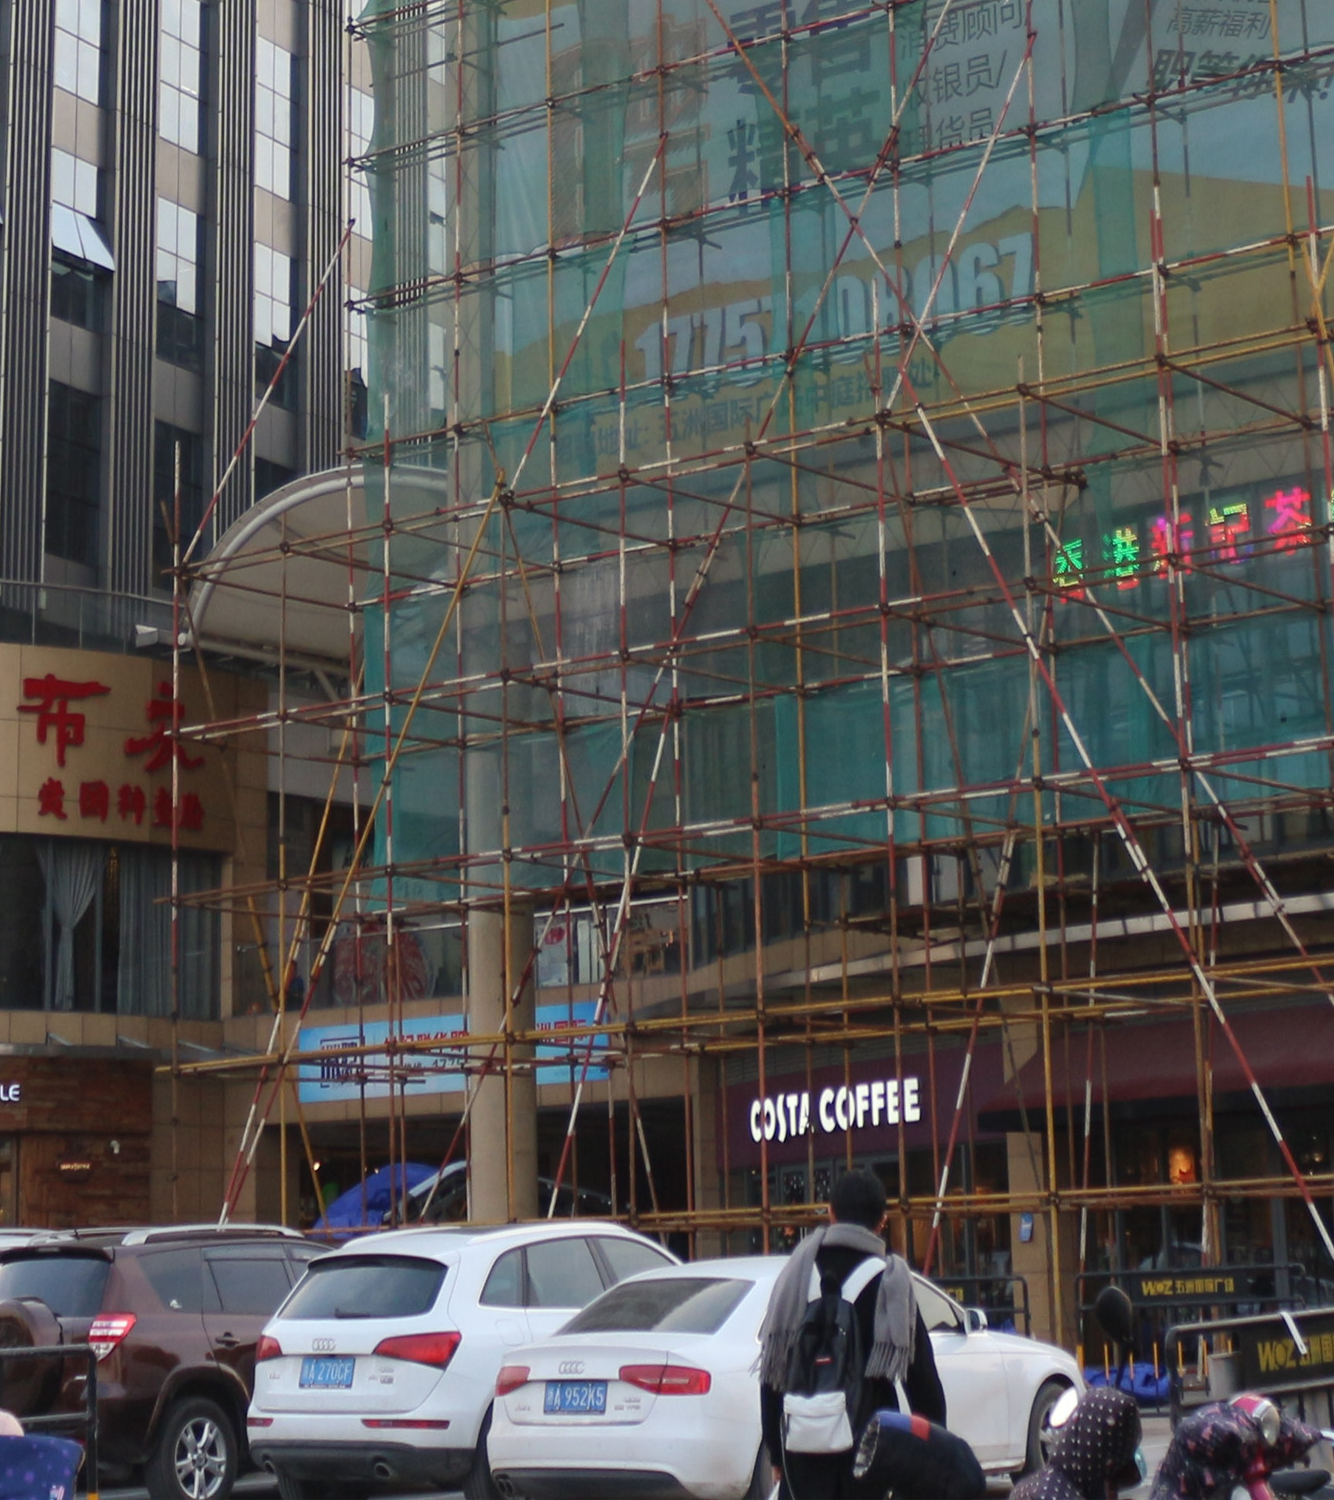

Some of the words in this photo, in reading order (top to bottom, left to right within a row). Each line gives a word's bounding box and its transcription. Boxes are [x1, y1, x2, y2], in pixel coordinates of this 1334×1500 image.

[1167, 6, 1276, 41] 高薪福利
[750, 1091, 815, 1143] COSTA
[819, 1076, 921, 1133] COFFEE
